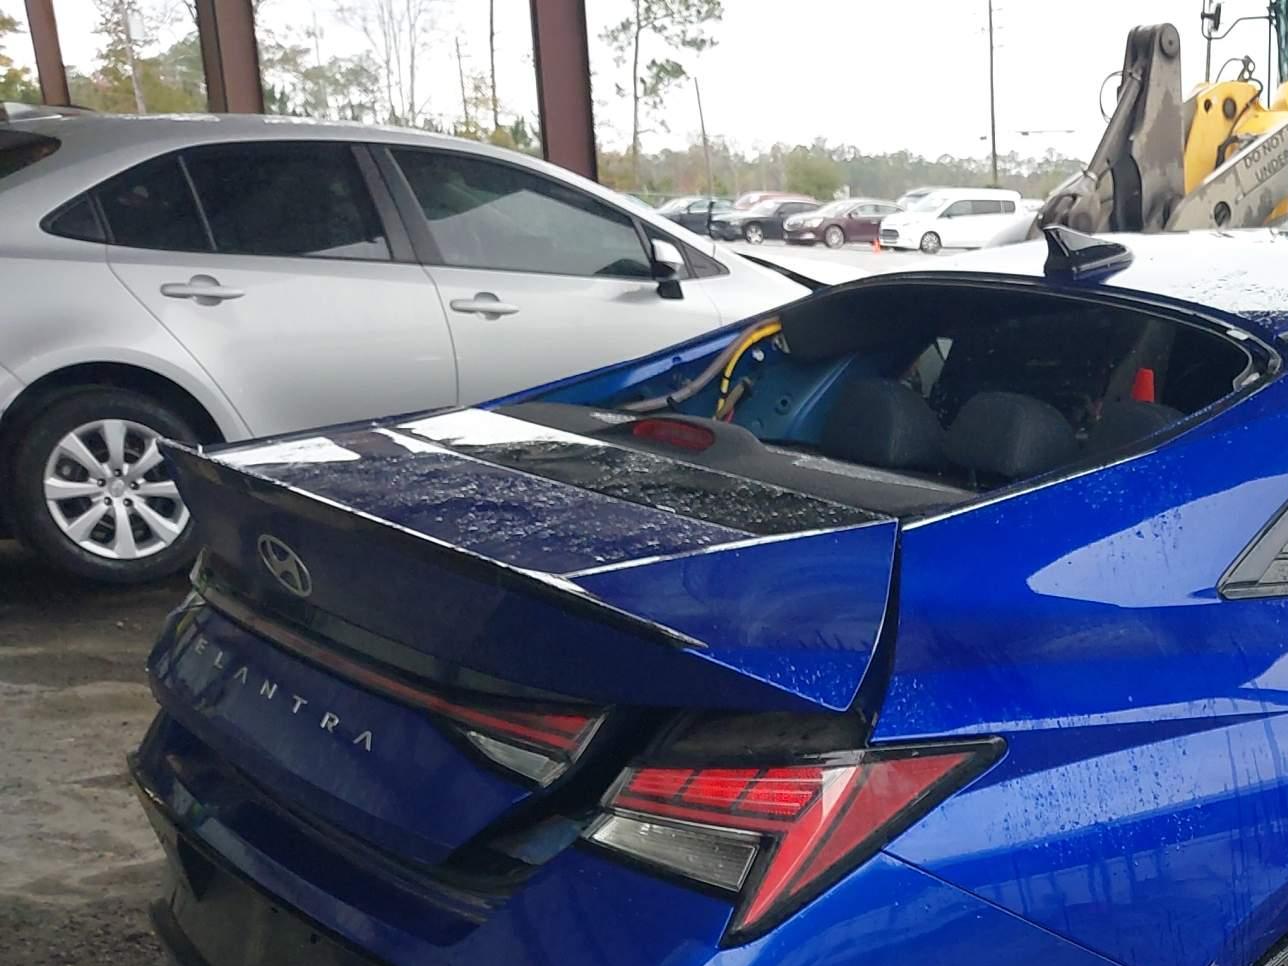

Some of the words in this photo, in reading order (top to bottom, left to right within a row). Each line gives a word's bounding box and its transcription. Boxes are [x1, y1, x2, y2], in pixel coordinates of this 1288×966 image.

[1244, 150, 1261, 169] DO
[1262, 129, 1285, 155] NOT
[195, 638, 373, 752] ELANTRA
